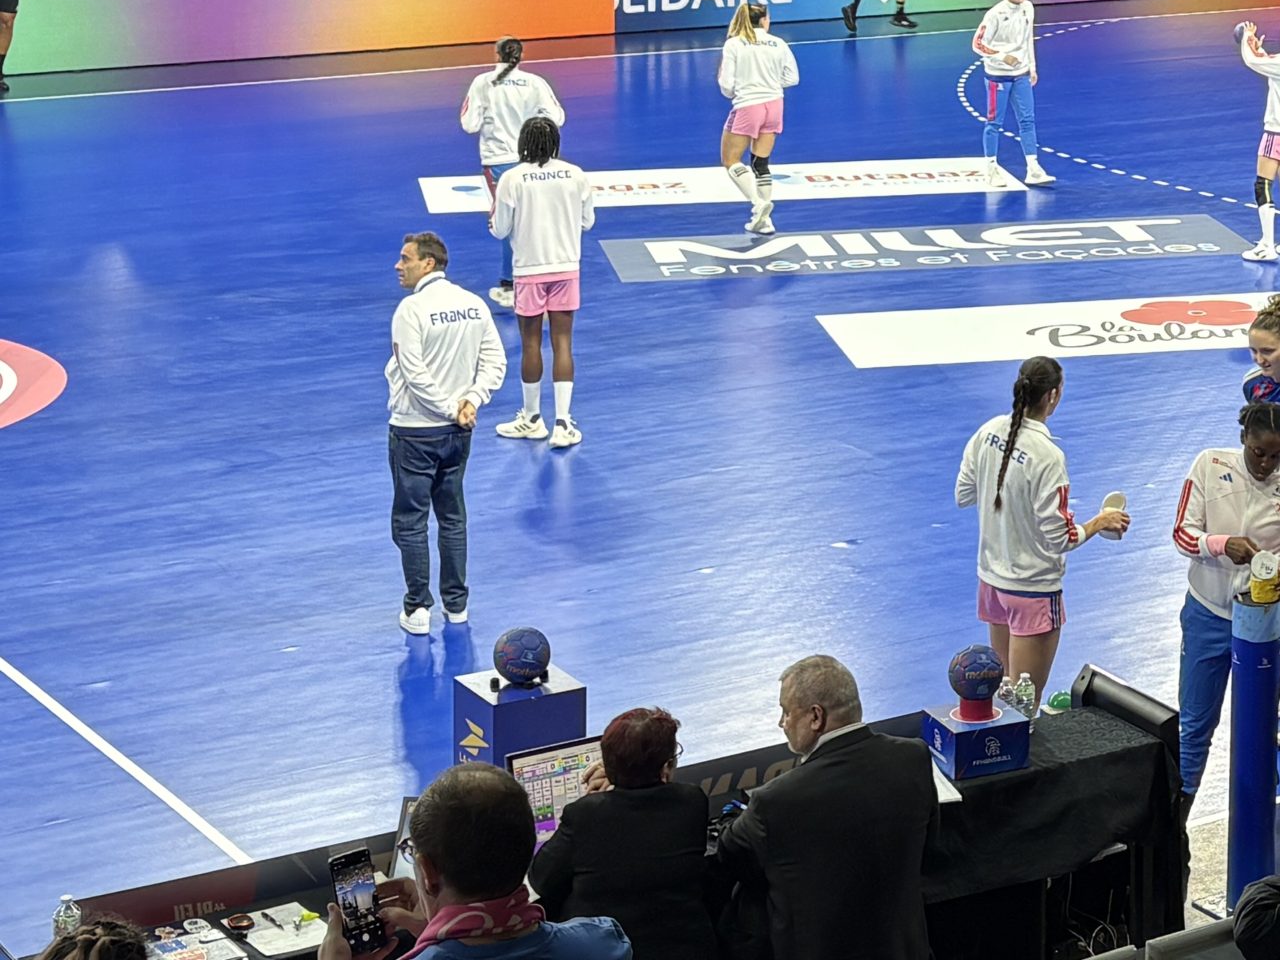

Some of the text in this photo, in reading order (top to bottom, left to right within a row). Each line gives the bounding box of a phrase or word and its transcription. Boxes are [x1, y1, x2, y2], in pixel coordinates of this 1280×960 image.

[643, 218, 1182, 263] MILLET
[659, 241, 1222, 277] Fenêtres et Façades
